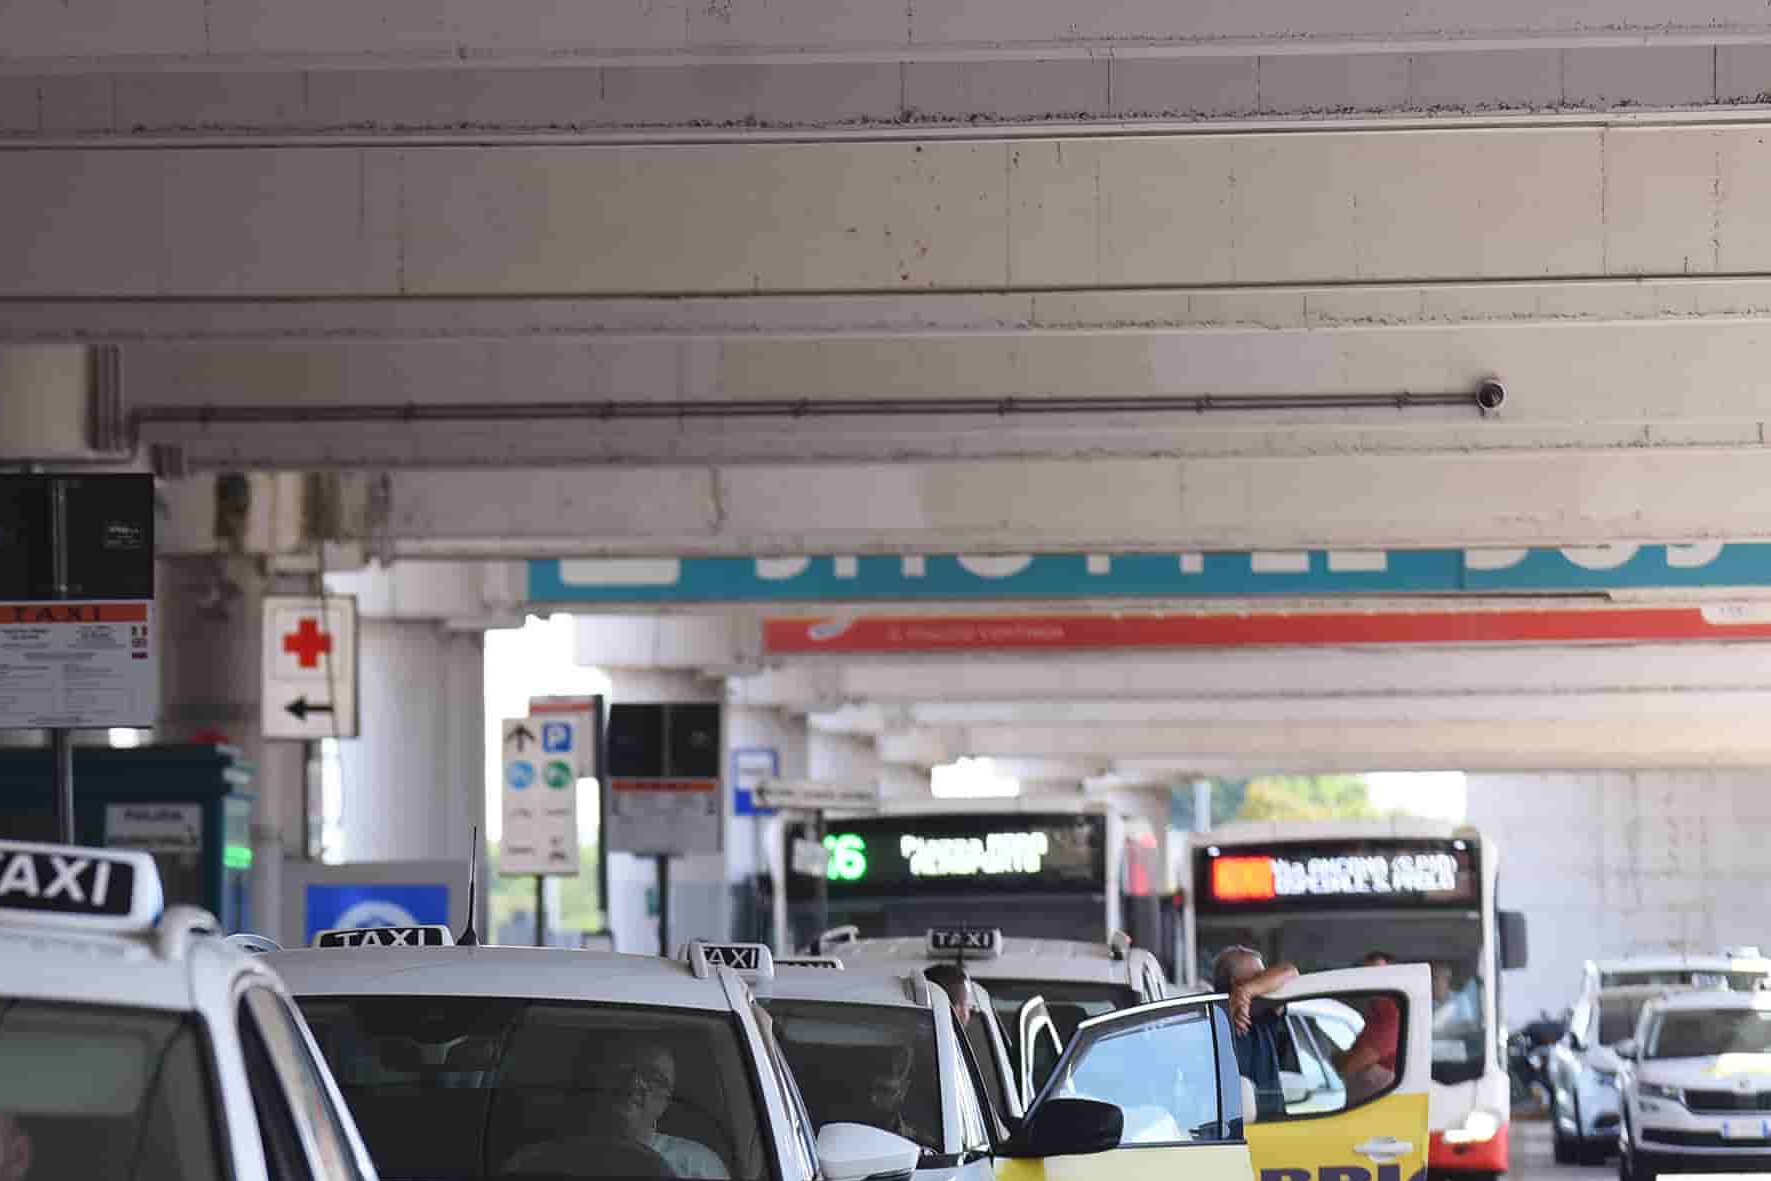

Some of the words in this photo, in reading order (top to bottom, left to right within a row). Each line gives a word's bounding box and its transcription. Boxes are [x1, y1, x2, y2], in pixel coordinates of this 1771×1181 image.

[11, 606, 101, 623] TAXI
[335, 929, 425, 947] TAXI
[937, 932, 992, 947] TAXI
[706, 949, 756, 968] AXI
